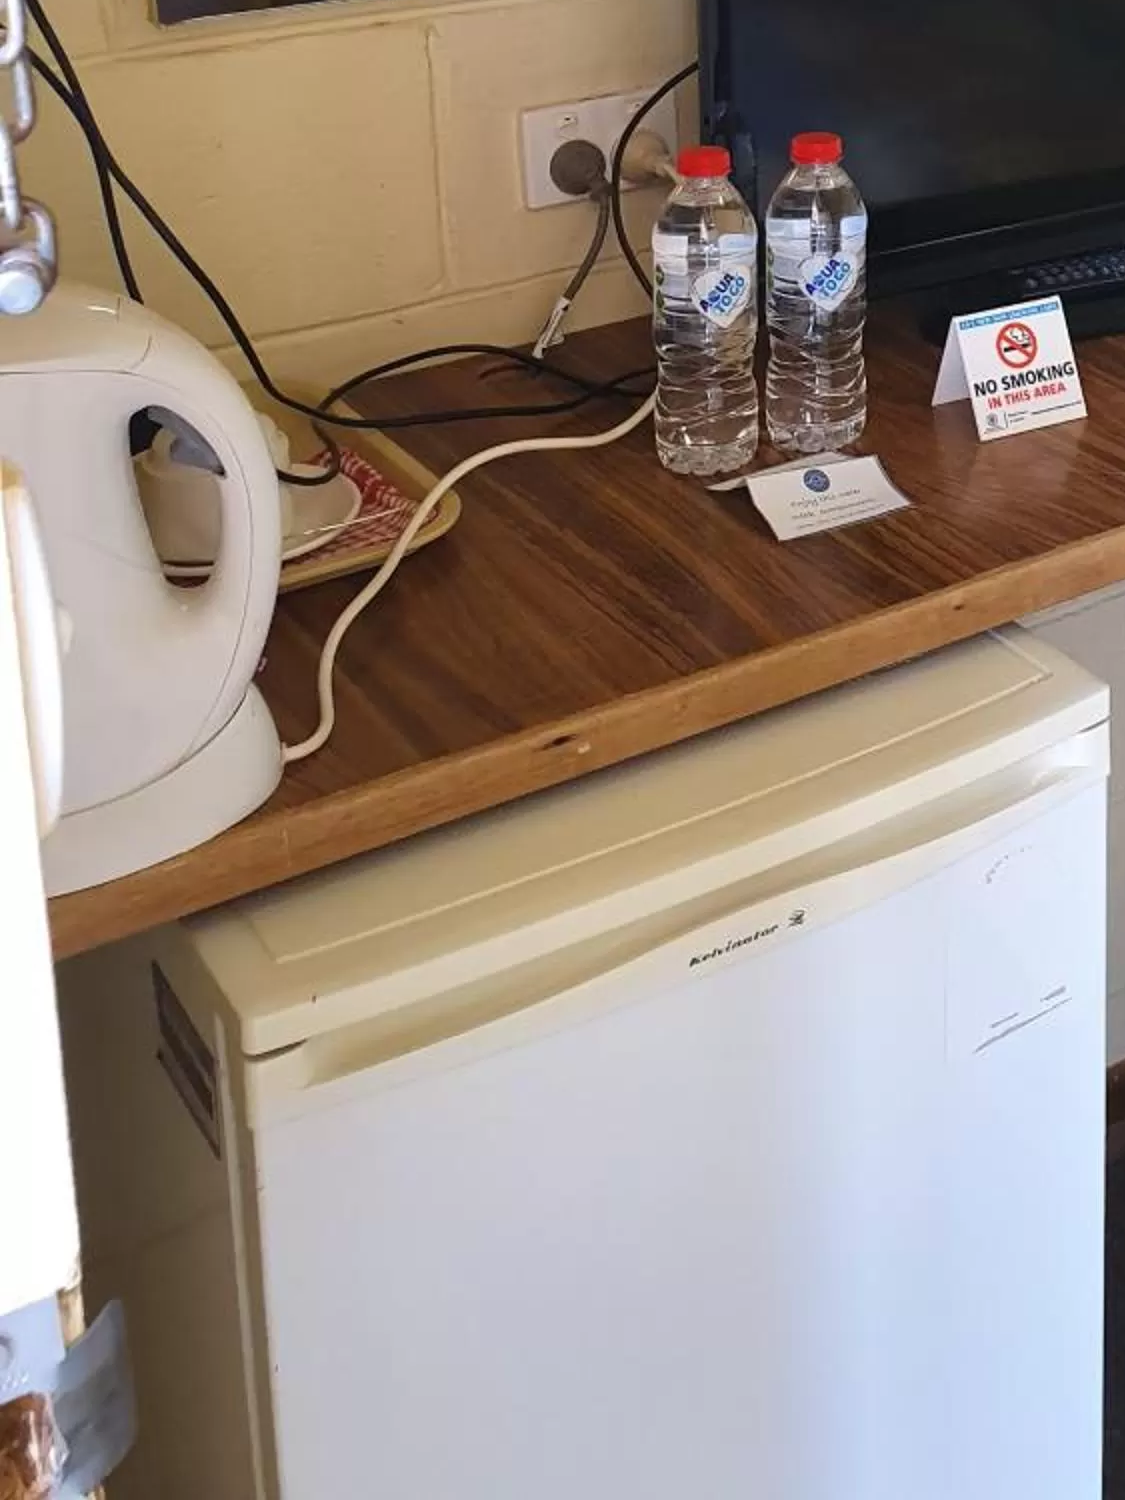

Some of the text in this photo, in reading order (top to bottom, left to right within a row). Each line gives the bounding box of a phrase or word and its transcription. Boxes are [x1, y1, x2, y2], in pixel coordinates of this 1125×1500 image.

[699, 272, 735, 313] AQUA
[804, 258, 842, 296] AQUA
[973, 361, 1075, 398] NO SMOKING
[987, 382, 1067, 410] IN THIS AREA
